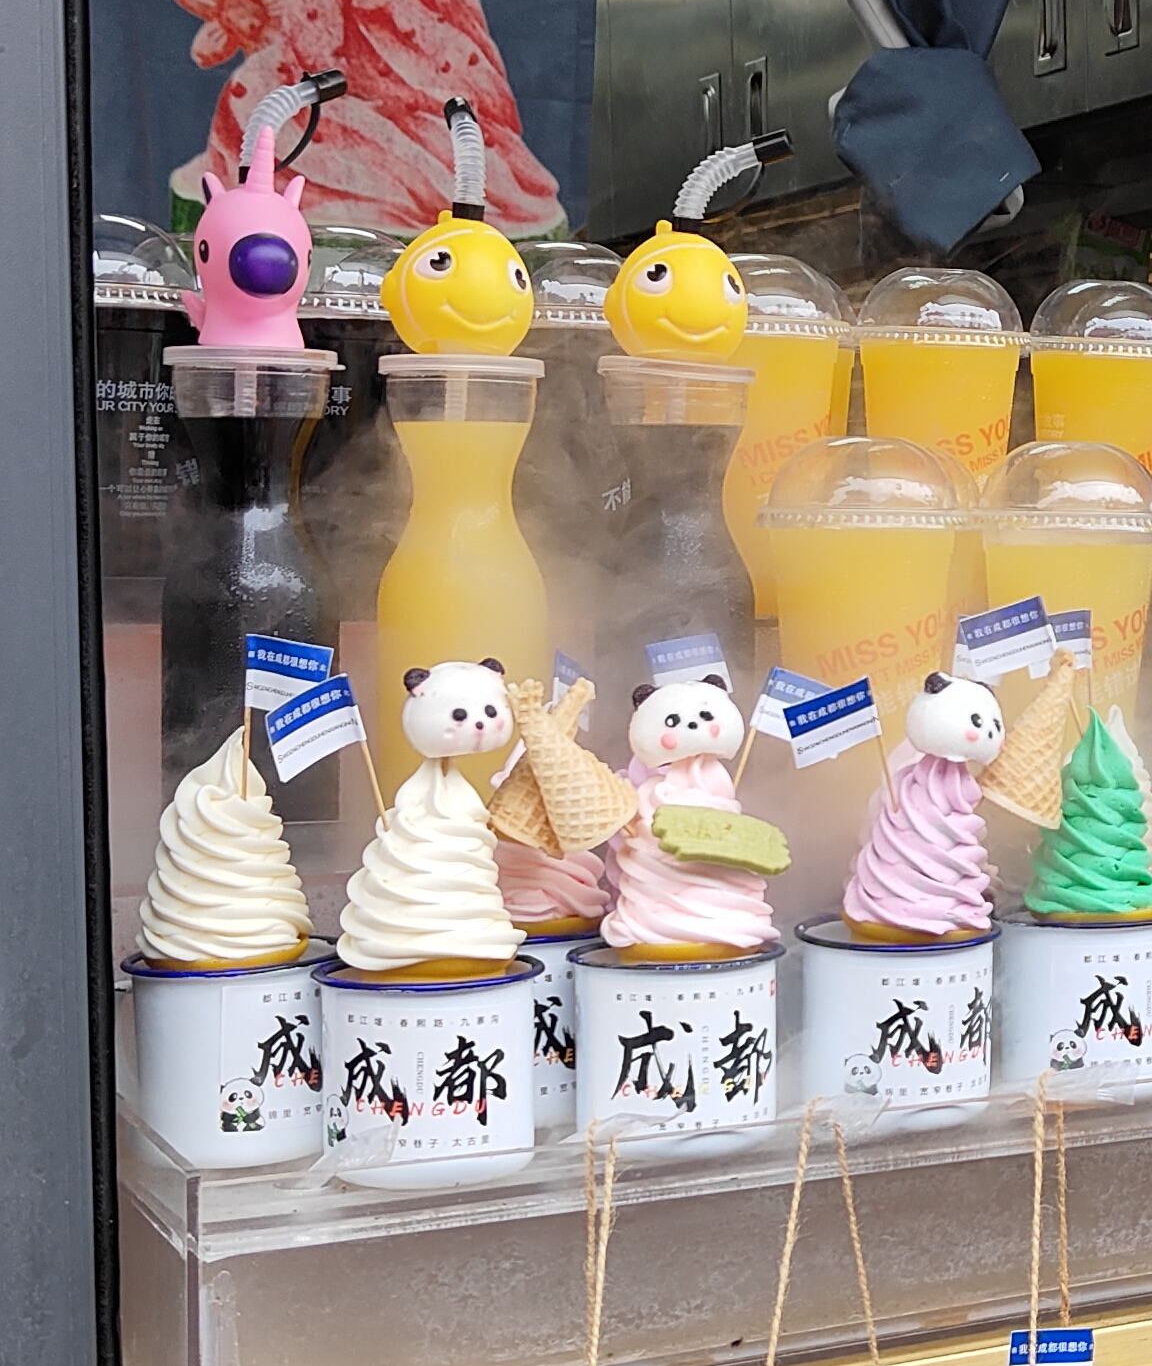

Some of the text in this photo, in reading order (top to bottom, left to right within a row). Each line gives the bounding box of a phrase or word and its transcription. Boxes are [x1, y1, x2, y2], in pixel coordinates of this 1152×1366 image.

[118, 401, 148, 412] CITY
[974, 610, 1040, 638] 我在成都很想你
[257, 648, 319, 672] 我在成都很想你
[816, 631, 899, 679] MISS
[275, 689, 343, 731] 我在成都很想你
[798, 690, 866, 726] 我在成都很想你
[399, 1018, 444, 1028] 春熙路
[459, 1014, 500, 1027] 九寨沟
[250, 1014, 324, 1093] 成
[611, 1010, 772, 1113] 成都
[341, 1035, 507, 1127] 成都
[416, 1051, 424, 1095] CHENGDU
[355, 1098, 488, 1117] CHENGDU
[452, 1134, 490, 1148] 太古里
[1018, 1341, 1088, 1356] 我成都很想你
